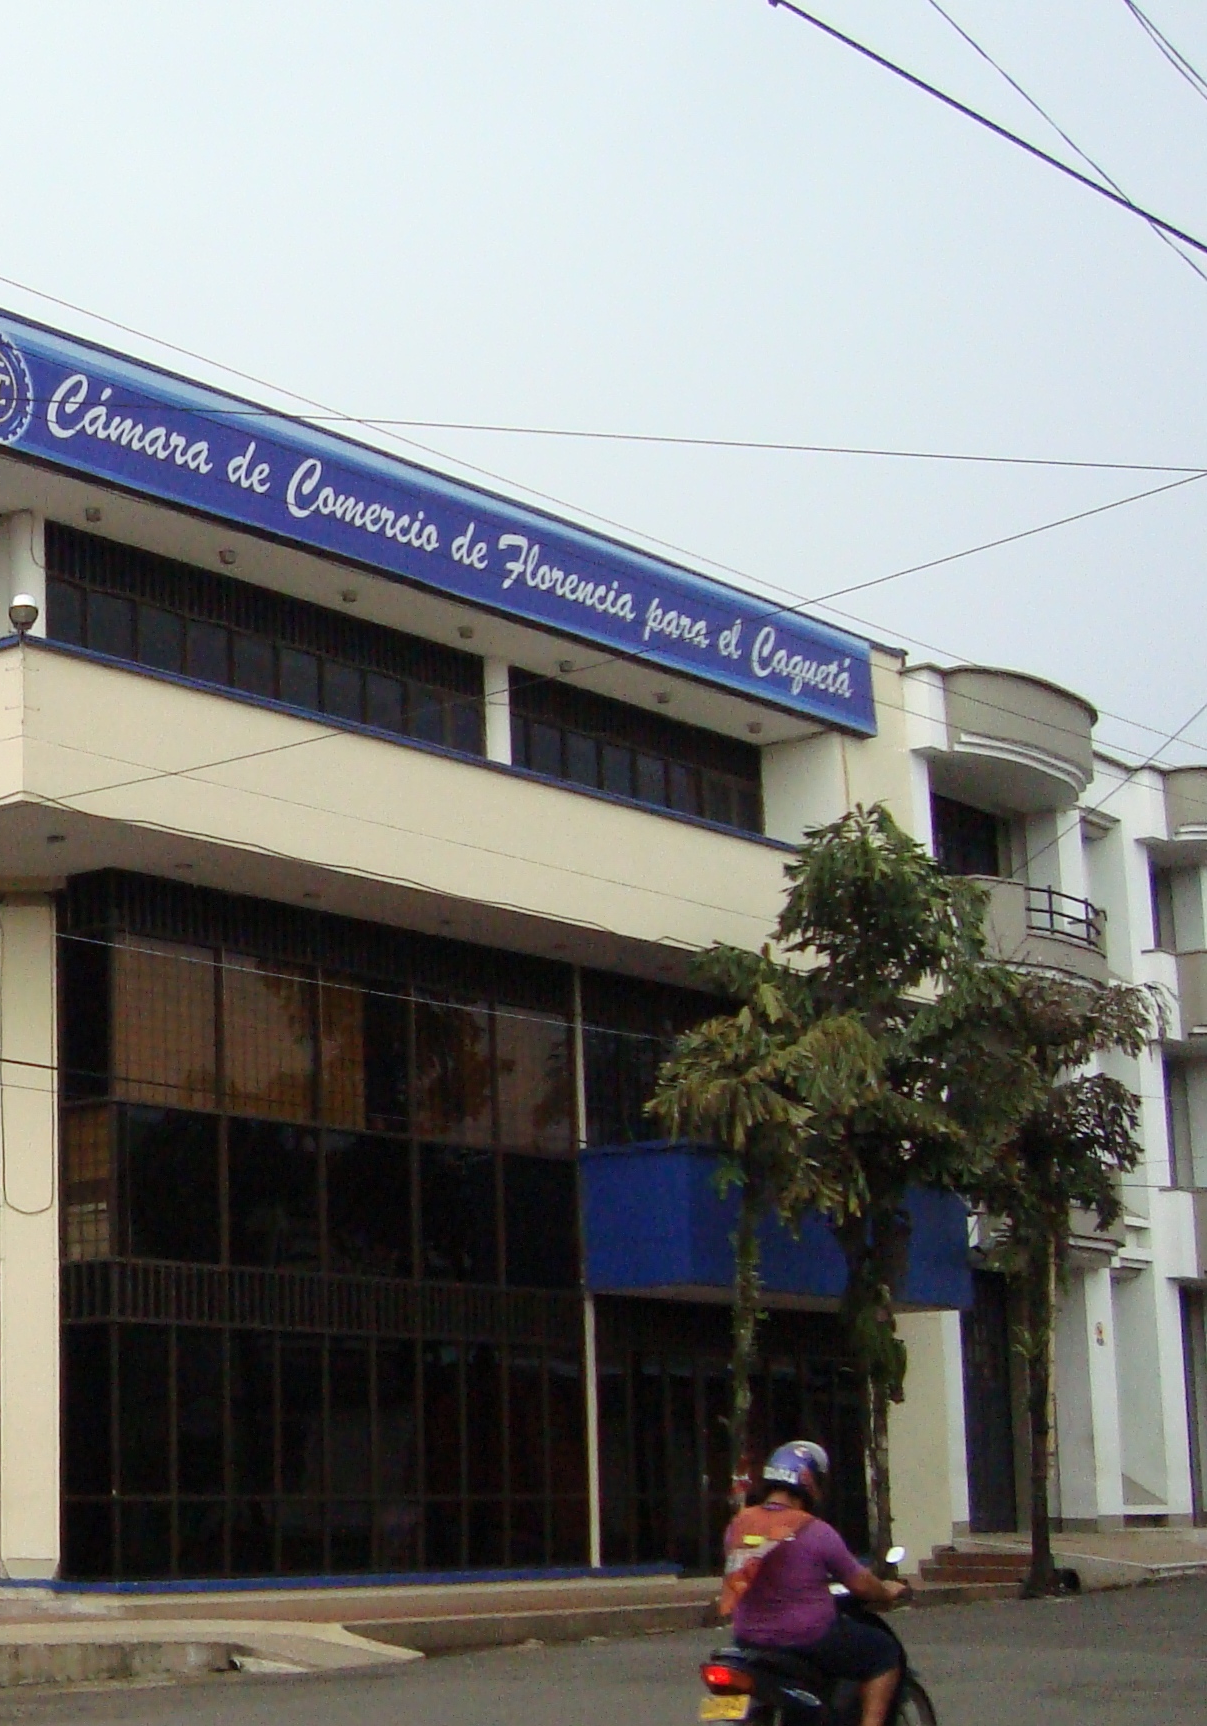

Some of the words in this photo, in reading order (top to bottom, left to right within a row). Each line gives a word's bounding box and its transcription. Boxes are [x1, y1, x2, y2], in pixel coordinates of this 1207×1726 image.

[46, 374, 213, 474] Cámara
[226, 442, 271, 494] de
[286, 457, 439, 552] Comercio
[451, 521, 488, 571] de
[498, 533, 636, 622] Florencia
[645, 597, 710, 648] para
[718, 618, 742, 659] el
[750, 626, 853, 698] Caquetá
